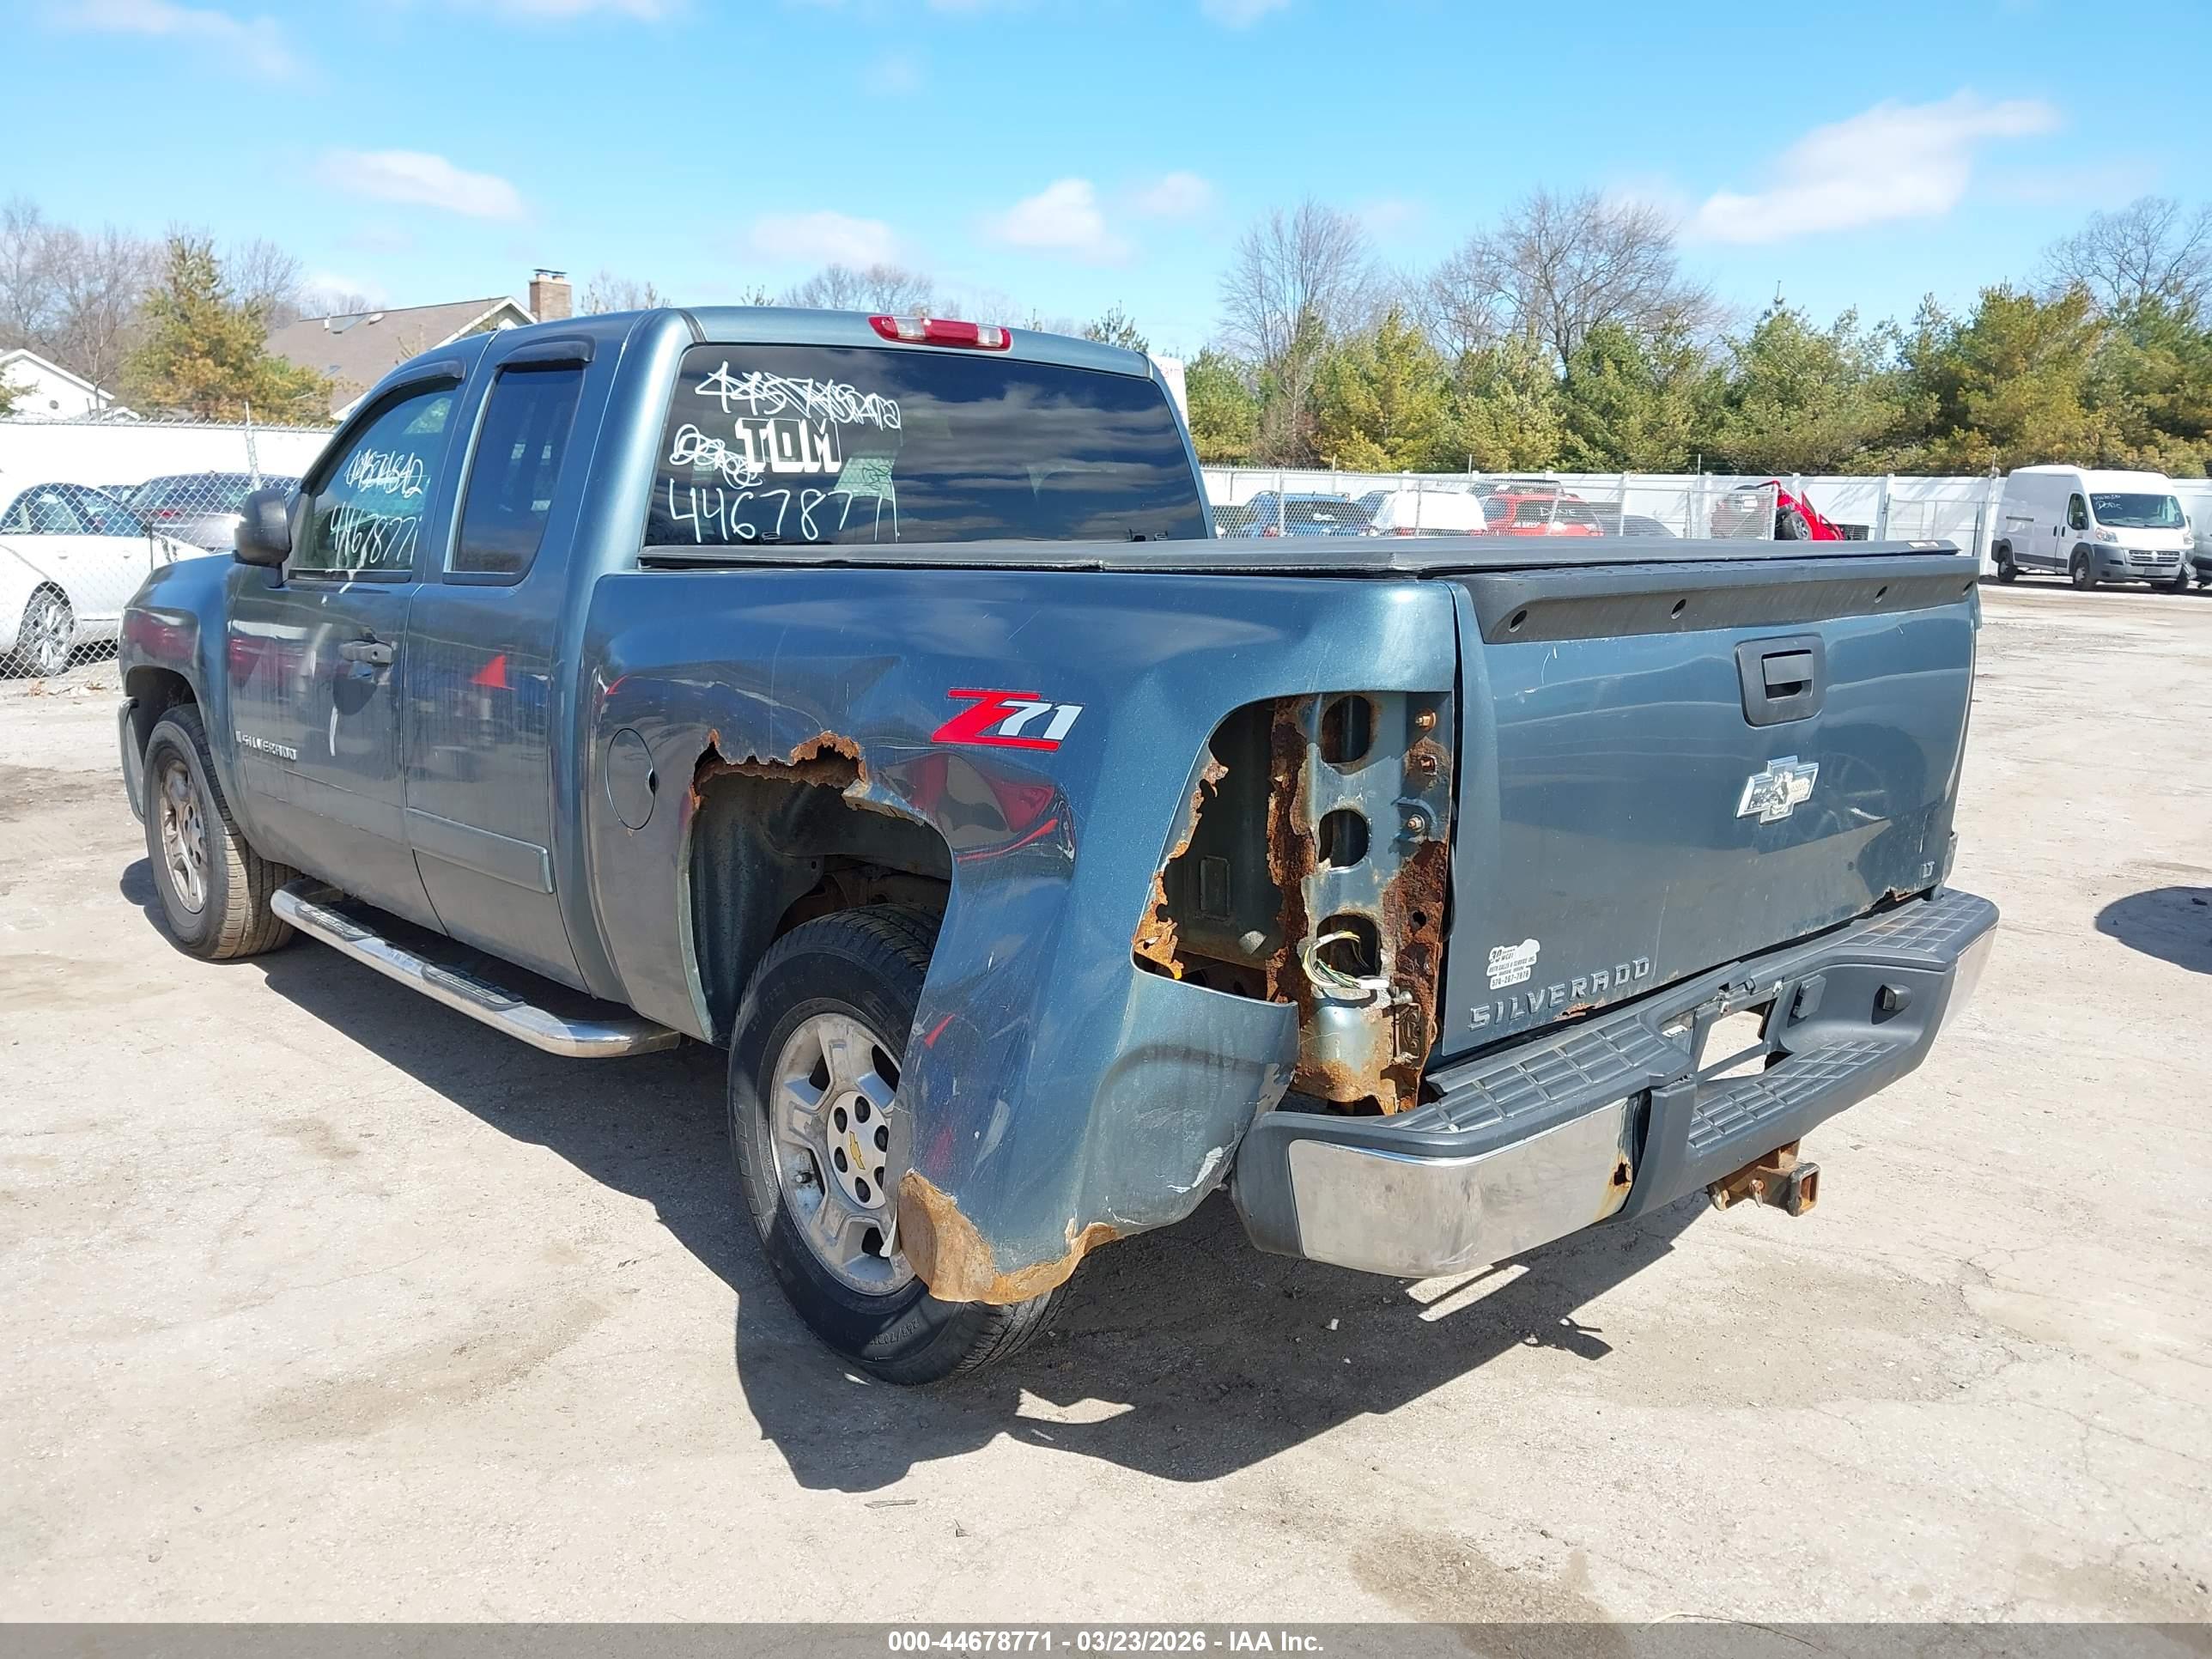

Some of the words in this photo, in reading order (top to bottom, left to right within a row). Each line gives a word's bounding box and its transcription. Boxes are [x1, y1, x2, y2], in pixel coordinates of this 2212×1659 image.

[735, 417, 842, 472] TOM
[242, 734, 297, 761] SILVERADO
[932, 687, 1085, 752] Z71
[1468, 956, 1650, 1030] SILVERADO
